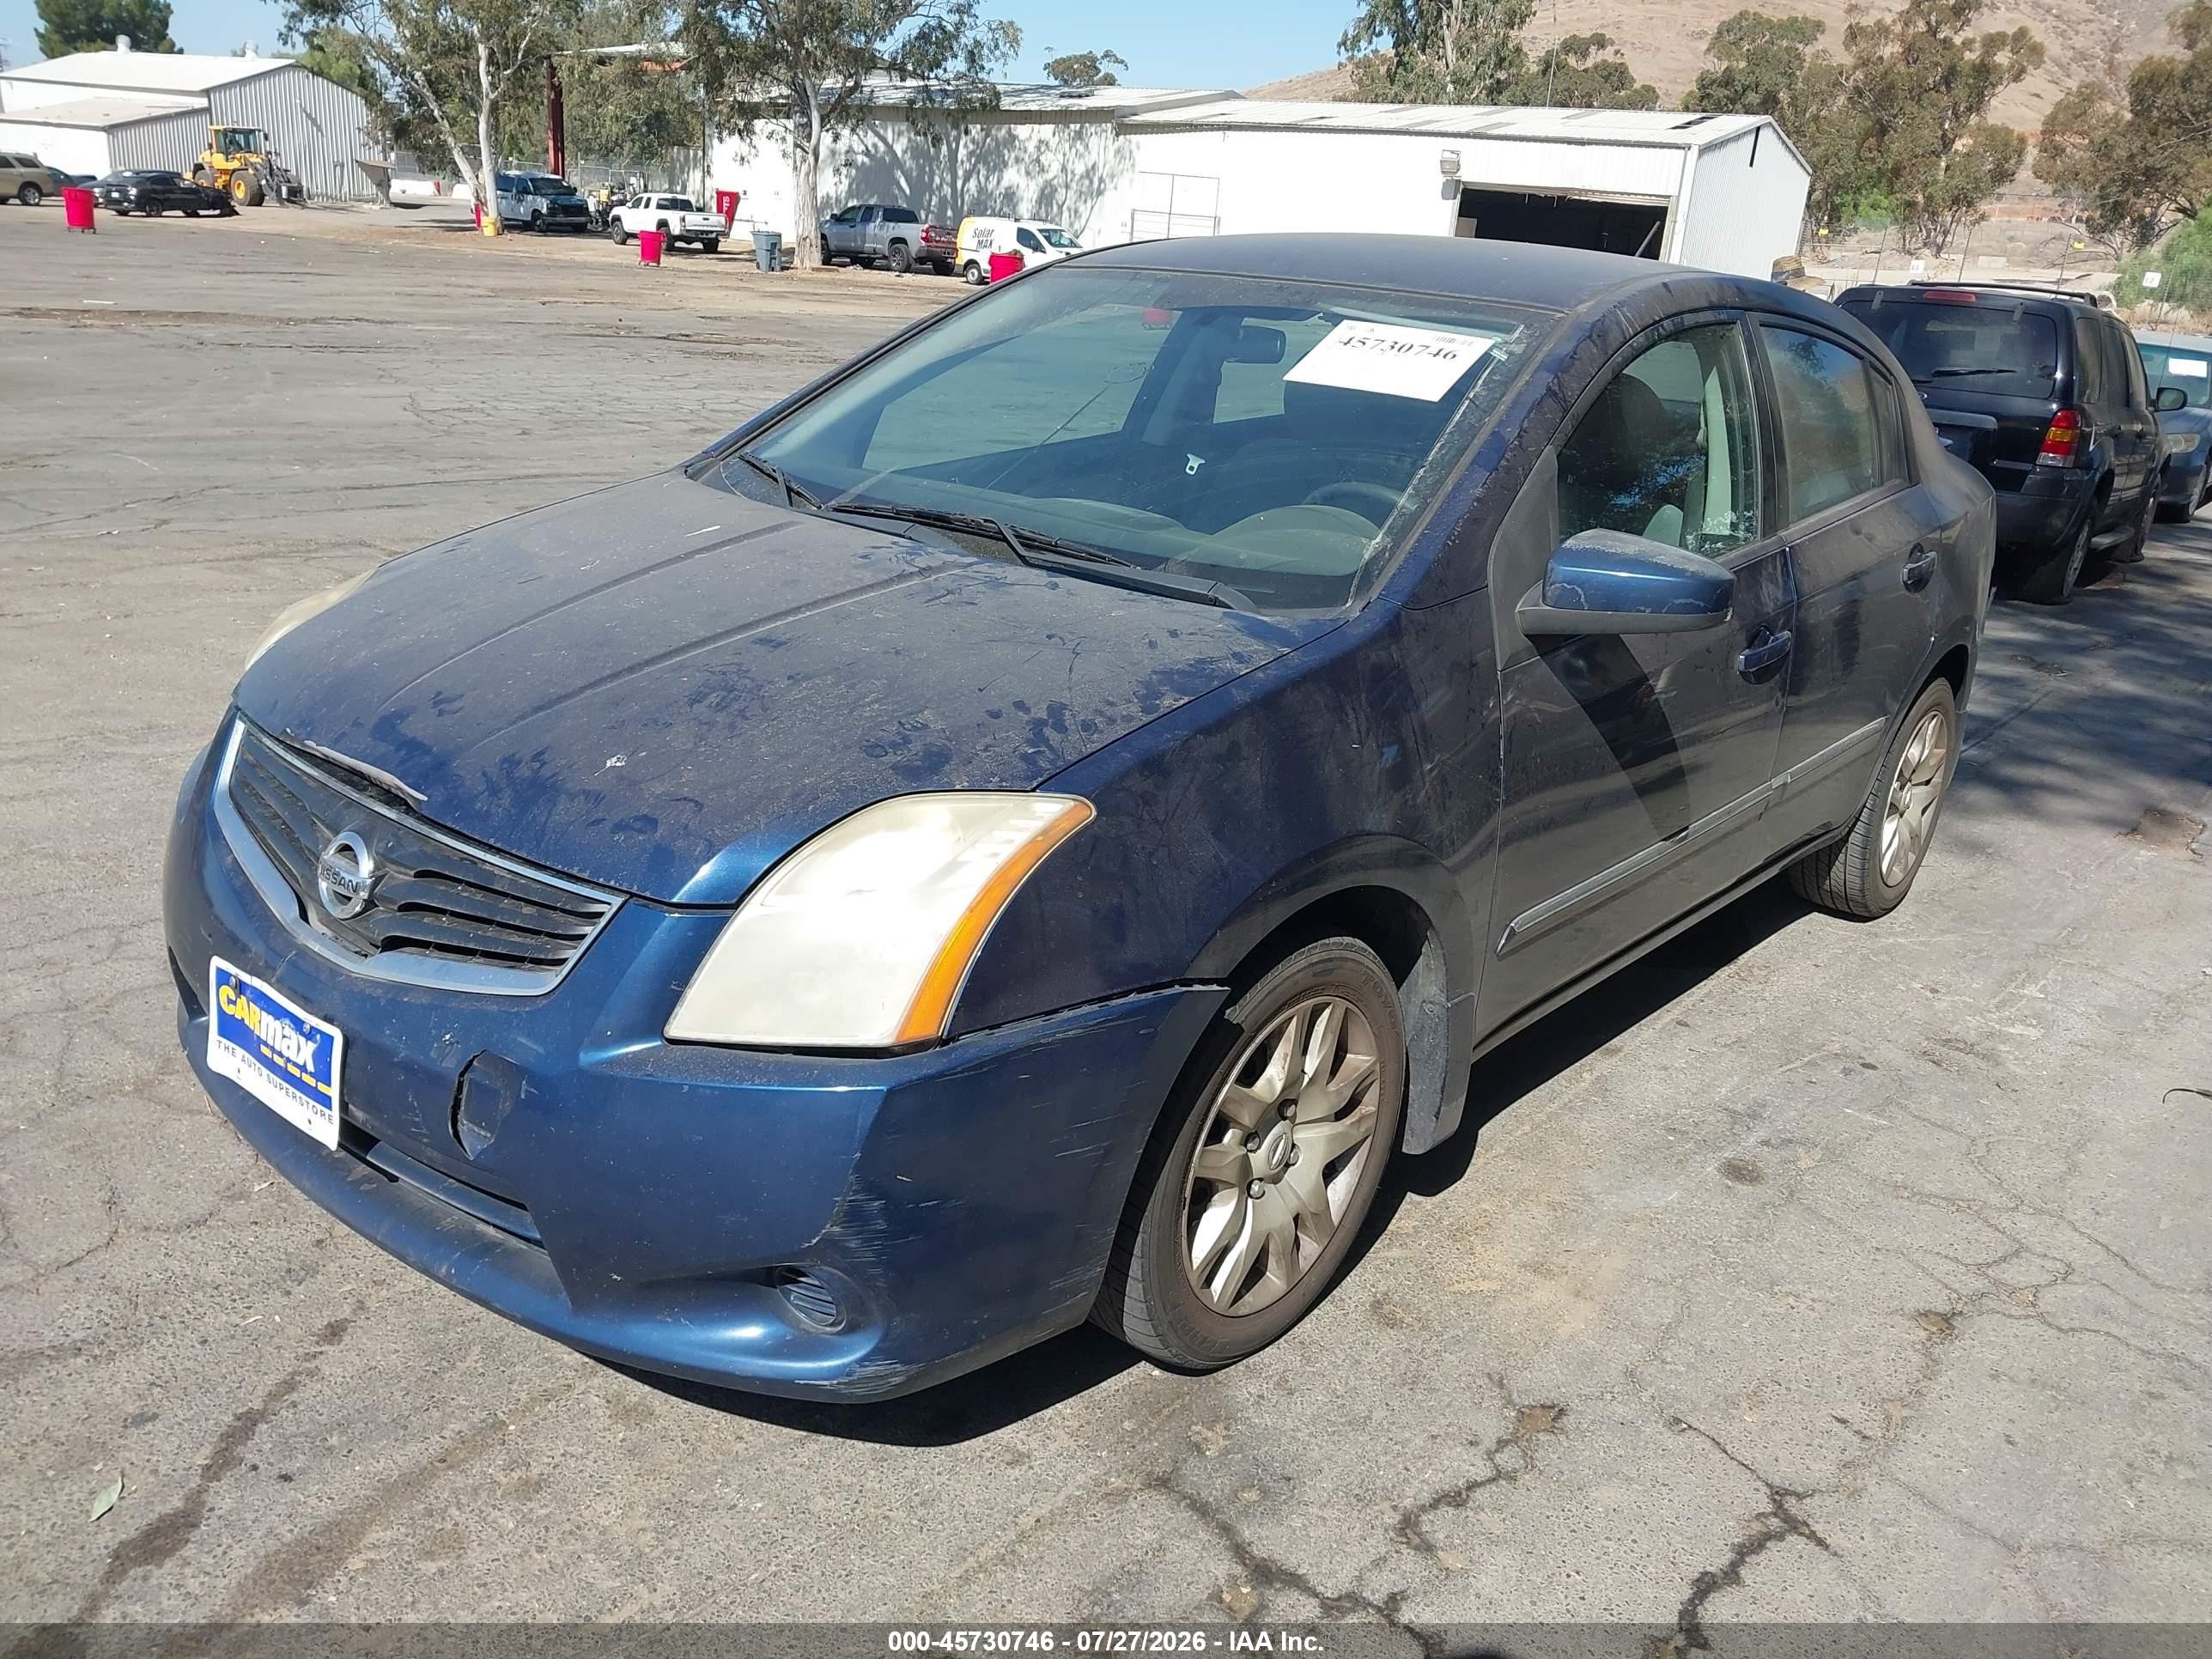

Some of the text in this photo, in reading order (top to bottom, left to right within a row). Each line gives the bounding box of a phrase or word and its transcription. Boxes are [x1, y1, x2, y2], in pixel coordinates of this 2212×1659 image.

[972, 228, 994, 239] Solar
[976, 239, 994, 249] MAX
[1339, 336, 1457, 362] 45730746
[216, 1040, 334, 1125] THE AUTO SUPERSTORE
